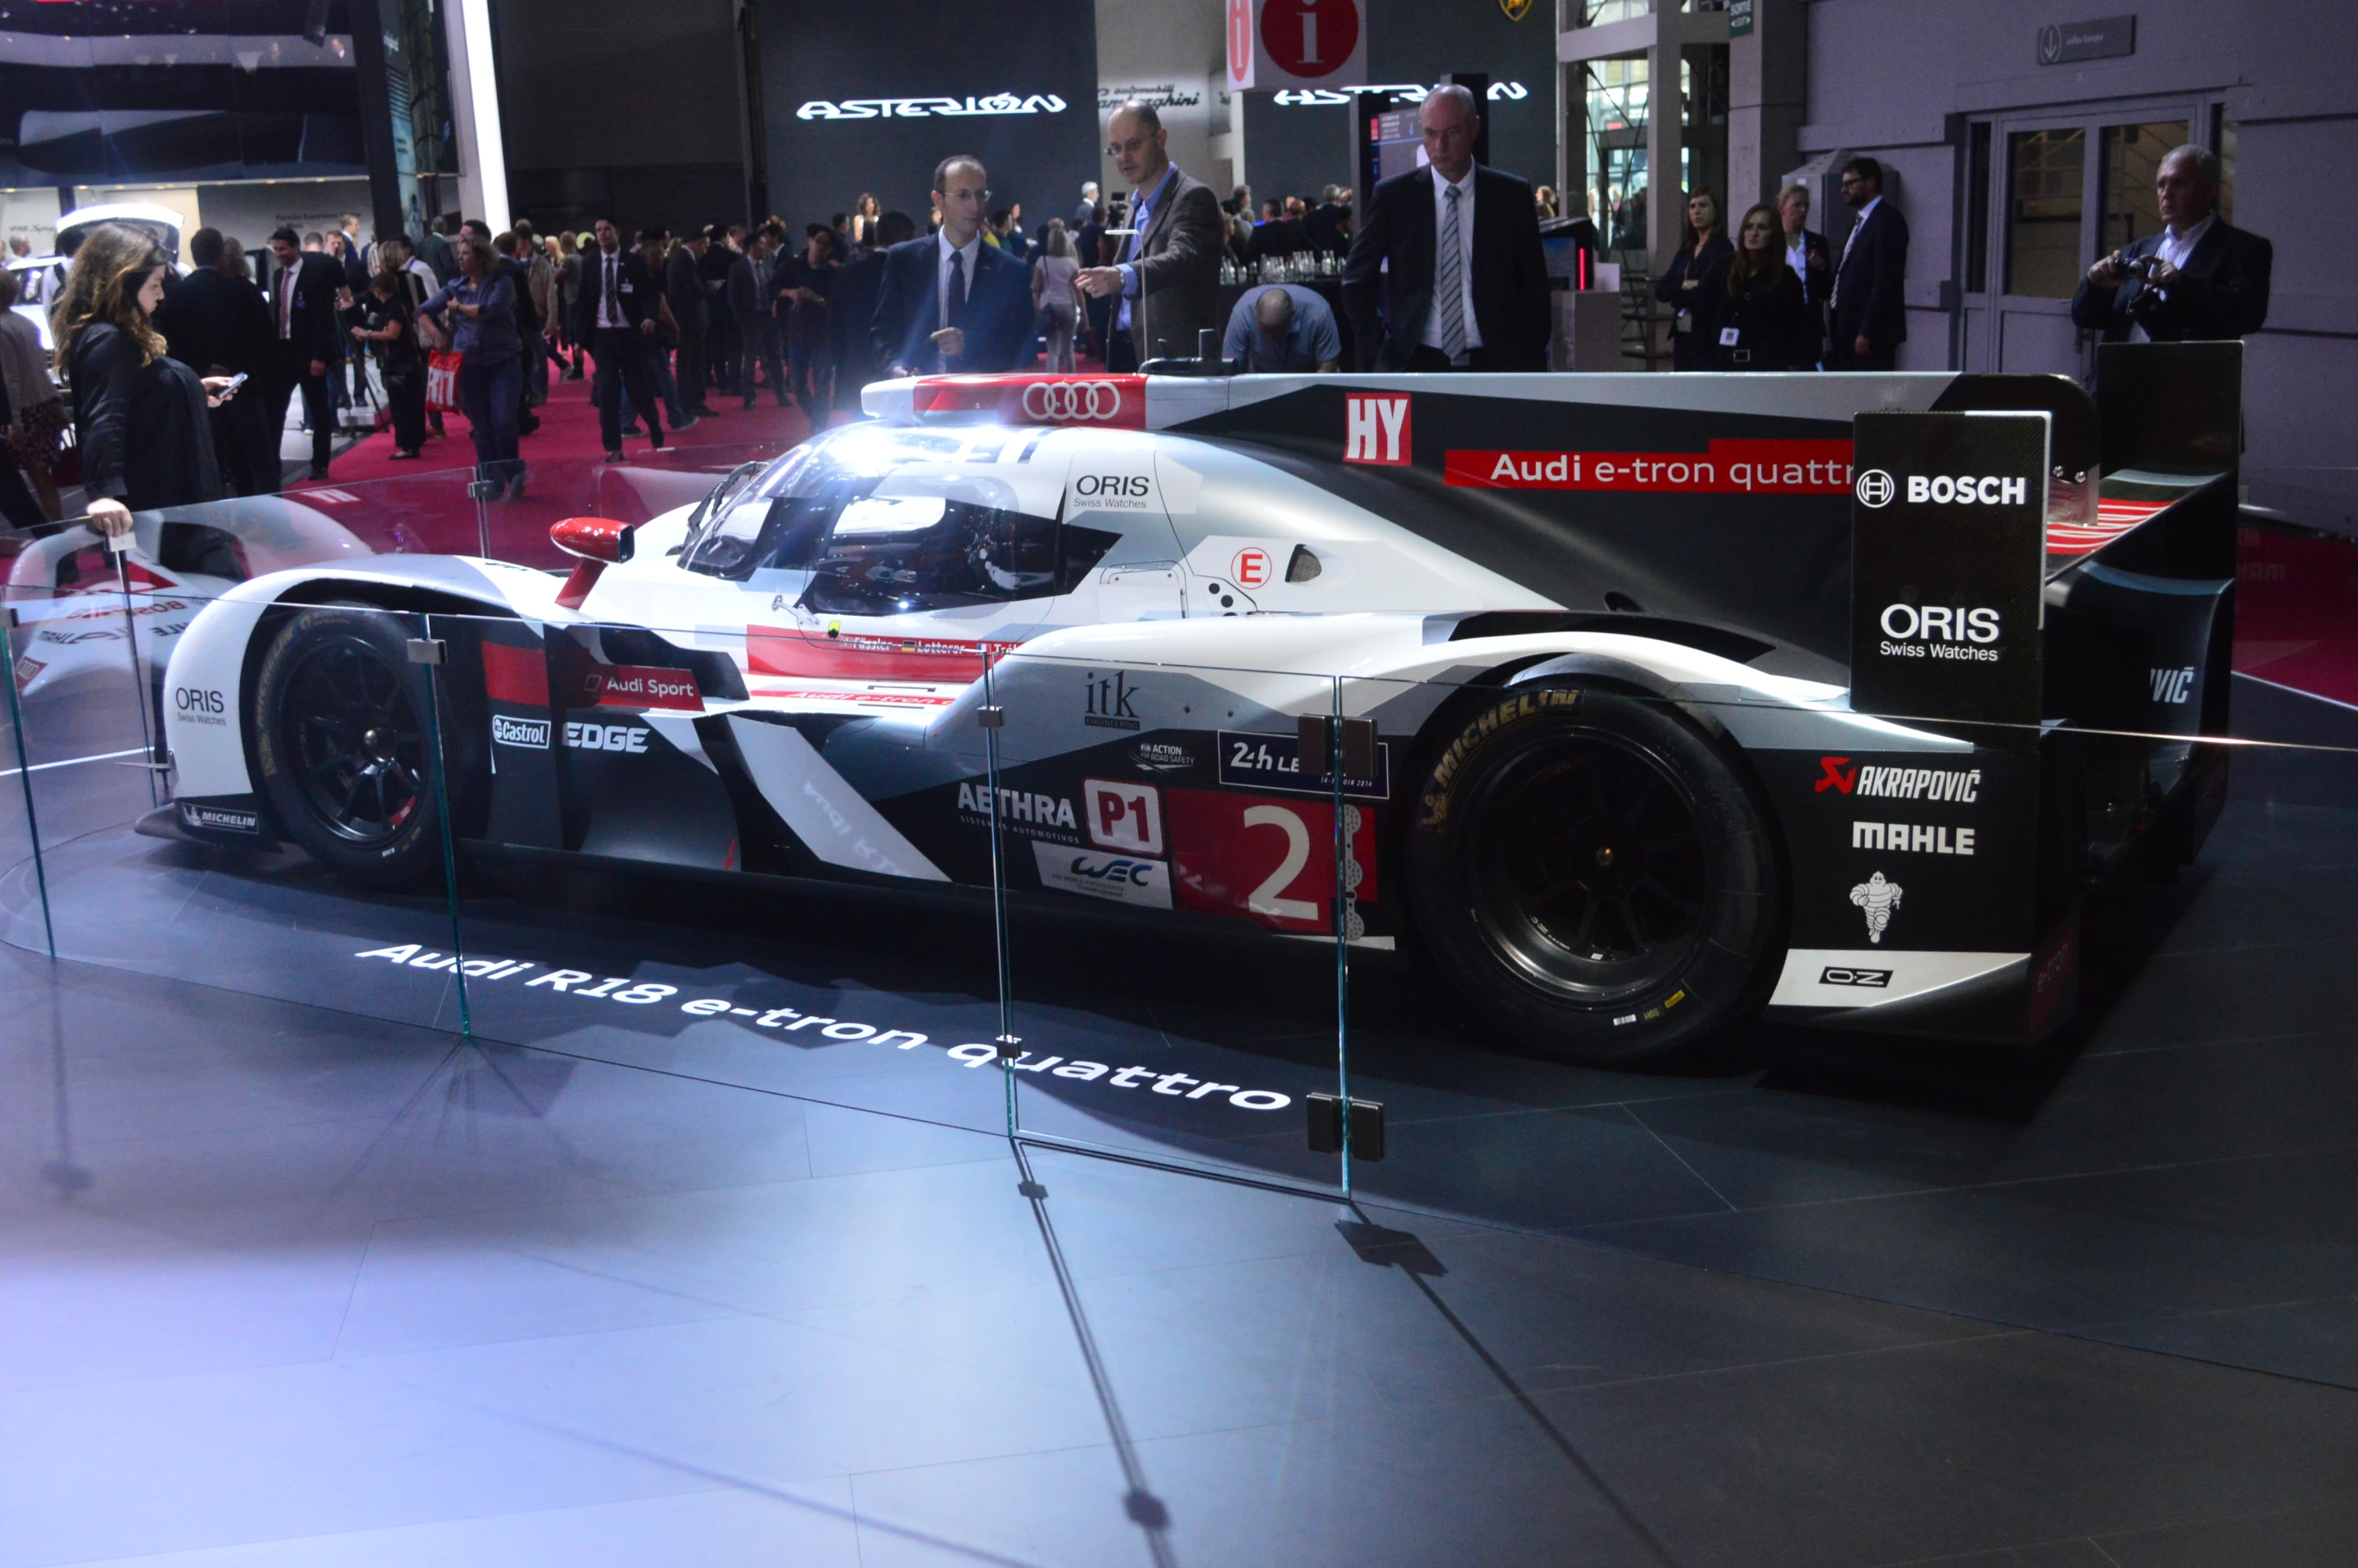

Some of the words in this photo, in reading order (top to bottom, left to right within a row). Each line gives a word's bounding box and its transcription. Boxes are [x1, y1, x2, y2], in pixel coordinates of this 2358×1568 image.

[1114, 84, 1175, 95] automobili
[796, 92, 1067, 120] ASTERION
[1346, 399, 1408, 460] HY
[1076, 475, 1150, 497] ORIS
[1490, 454, 1581, 481] Audi
[1595, 457, 1714, 484] e-tron
[1729, 459, 1854, 490] quattr
[1074, 498, 1101, 507] Swiss
[1104, 498, 1147, 508] Watches
[1908, 475, 2026, 504] BOSCH
[1240, 554, 1263, 583] E
[1881, 603, 2000, 643] ORIS
[994, 643, 1018, 655] Trél
[1880, 641, 1925, 657] Swiss
[1930, 643, 1999, 662] Watches
[176, 687, 224, 713] ORIS
[607, 678, 643, 693] Audi
[648, 679, 694, 698] Sport
[1085, 669, 1141, 719] itk
[177, 712, 196, 722] Swiss
[196, 714, 226, 726] Watches
[503, 722, 545, 743] Castrol
[562, 721, 651, 753] EDGE
[1153, 743, 1182, 755] ACTION
[1434, 689, 1580, 789] MICHELIN
[1150, 753, 1169, 762] ROAD
[1169, 755, 1195, 764] SAFETY
[1341, 778, 1356, 786] UIN
[202, 811, 256, 827] MICHELIN
[958, 782, 1077, 830] AETHRA
[1097, 790, 1150, 843] P1
[960, 815, 1008, 831] SISTEMS
[1013, 825, 1080, 844] AUTOMOTIVOS
[1853, 821, 1975, 855] MAHLE
[1071, 856, 1154, 887] WEC
[1244, 805, 1319, 921] 2
[355, 943, 534, 980] Audi
[524, 969, 678, 1005] R18
[680, 997, 928, 1051] e-tron
[946, 1042, 1291, 1110] quattro
